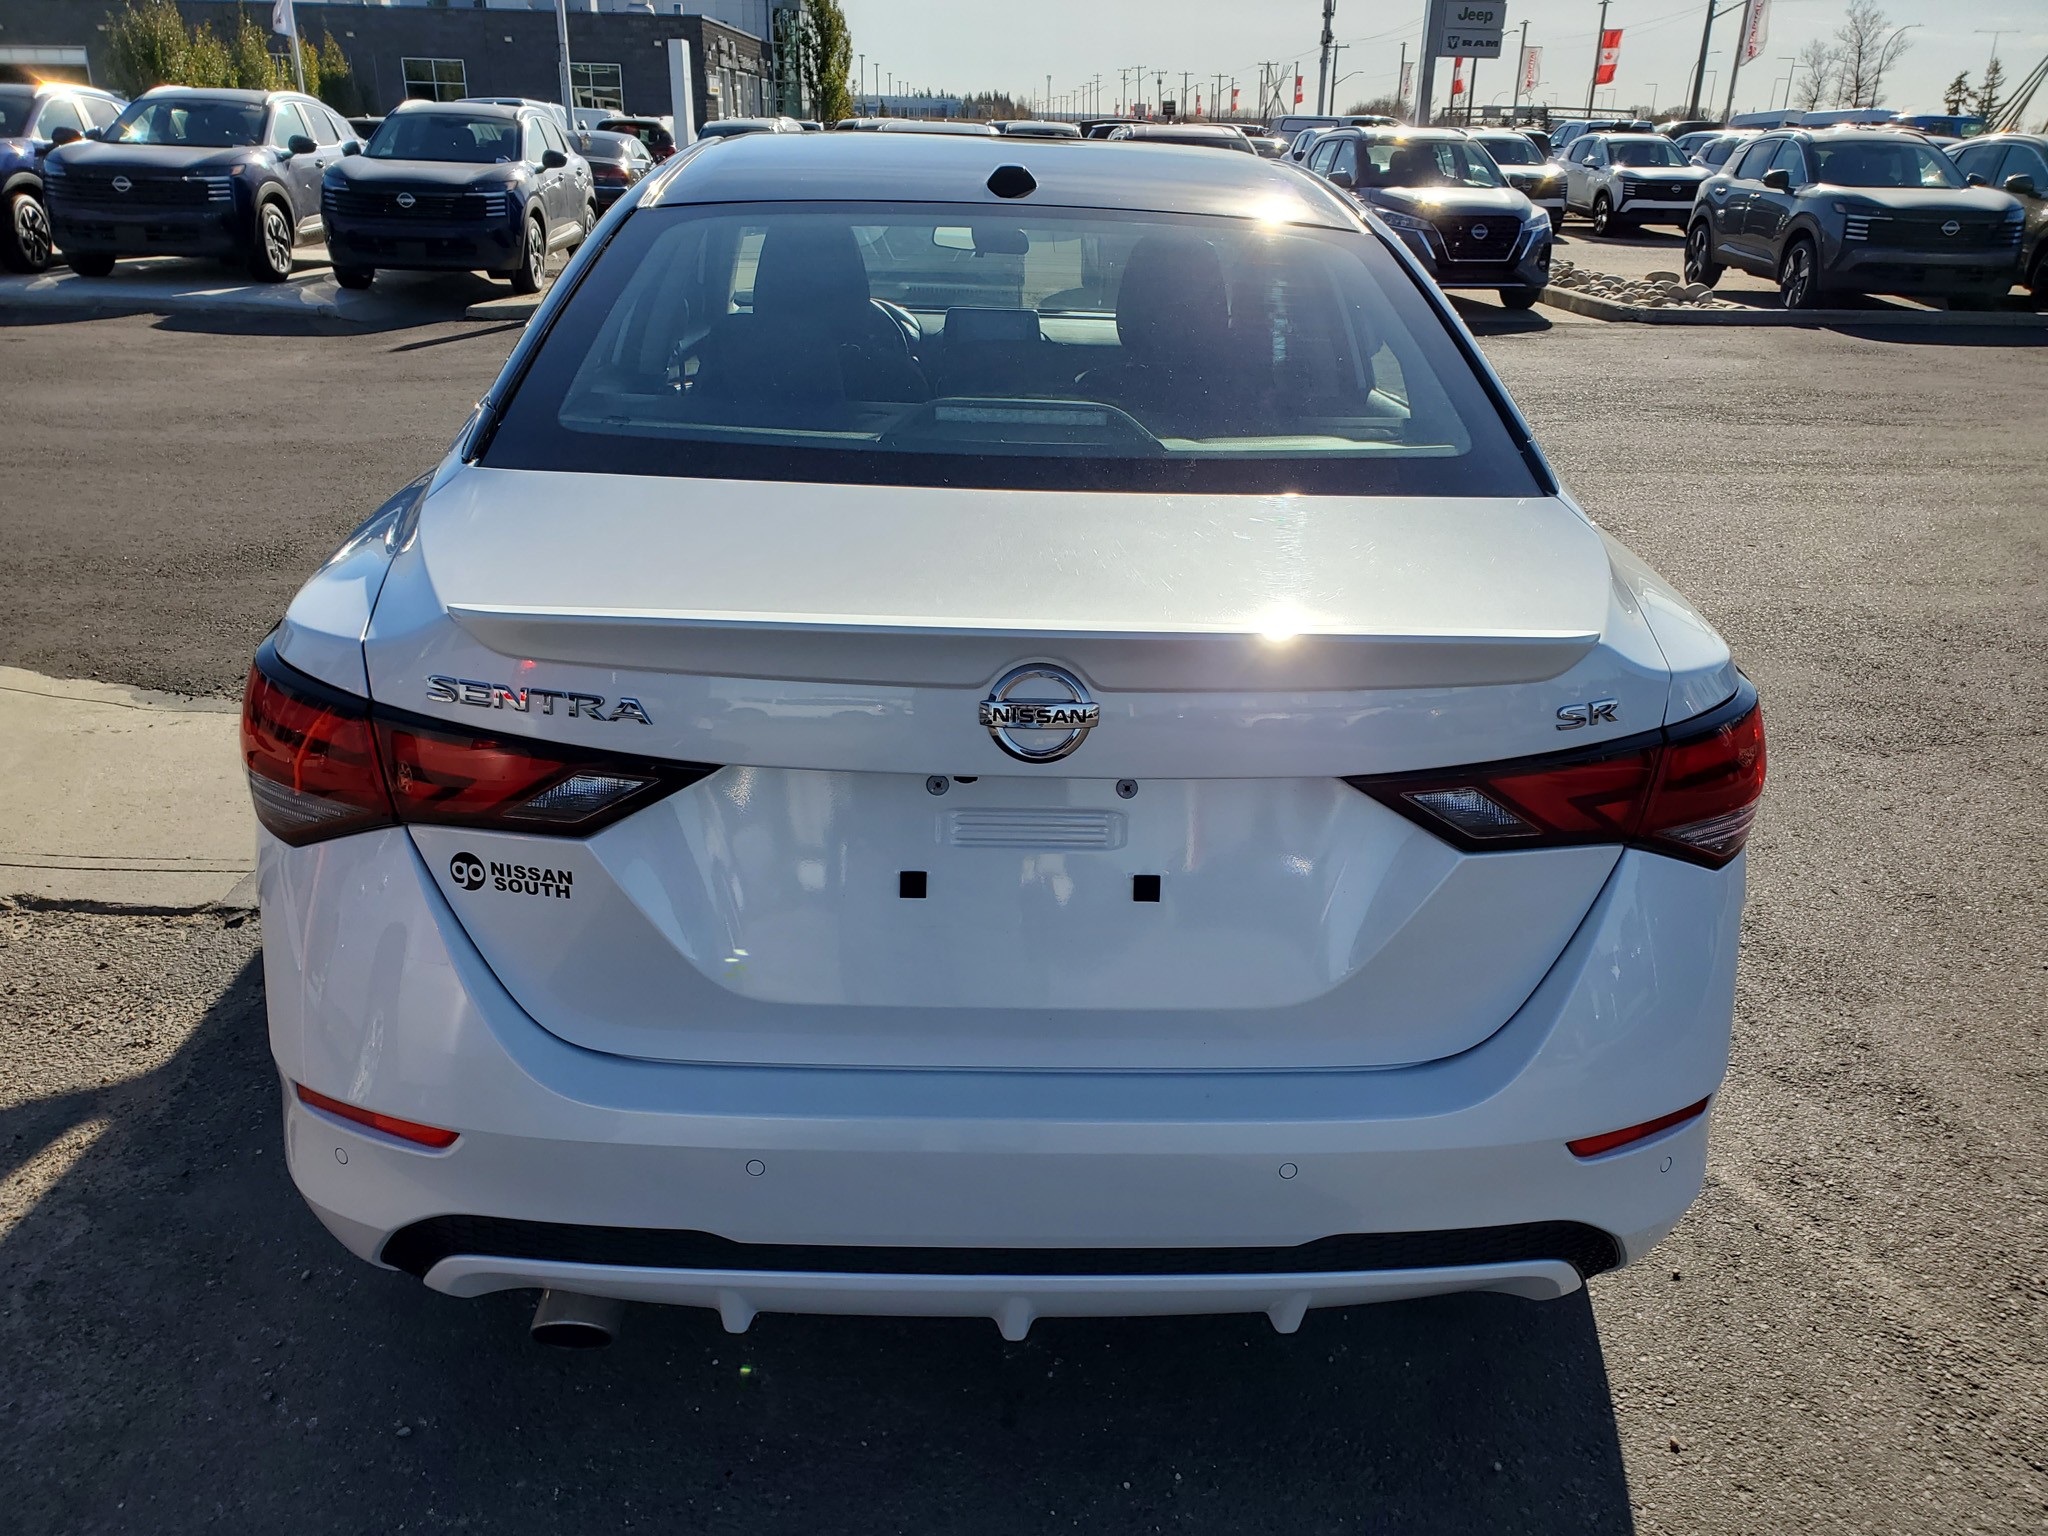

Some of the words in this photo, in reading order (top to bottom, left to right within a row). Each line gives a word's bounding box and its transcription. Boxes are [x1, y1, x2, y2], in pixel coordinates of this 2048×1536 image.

[1457, 6, 1494, 24] Jeep
[1462, 39, 1499, 47] RAM
[426, 674, 653, 725] SENTRA
[992, 707, 1087, 724] NISSAN
[1555, 697, 1619, 731] SR
[490, 861, 573, 885] NISSAN
[494, 877, 571, 899] SOUTH
